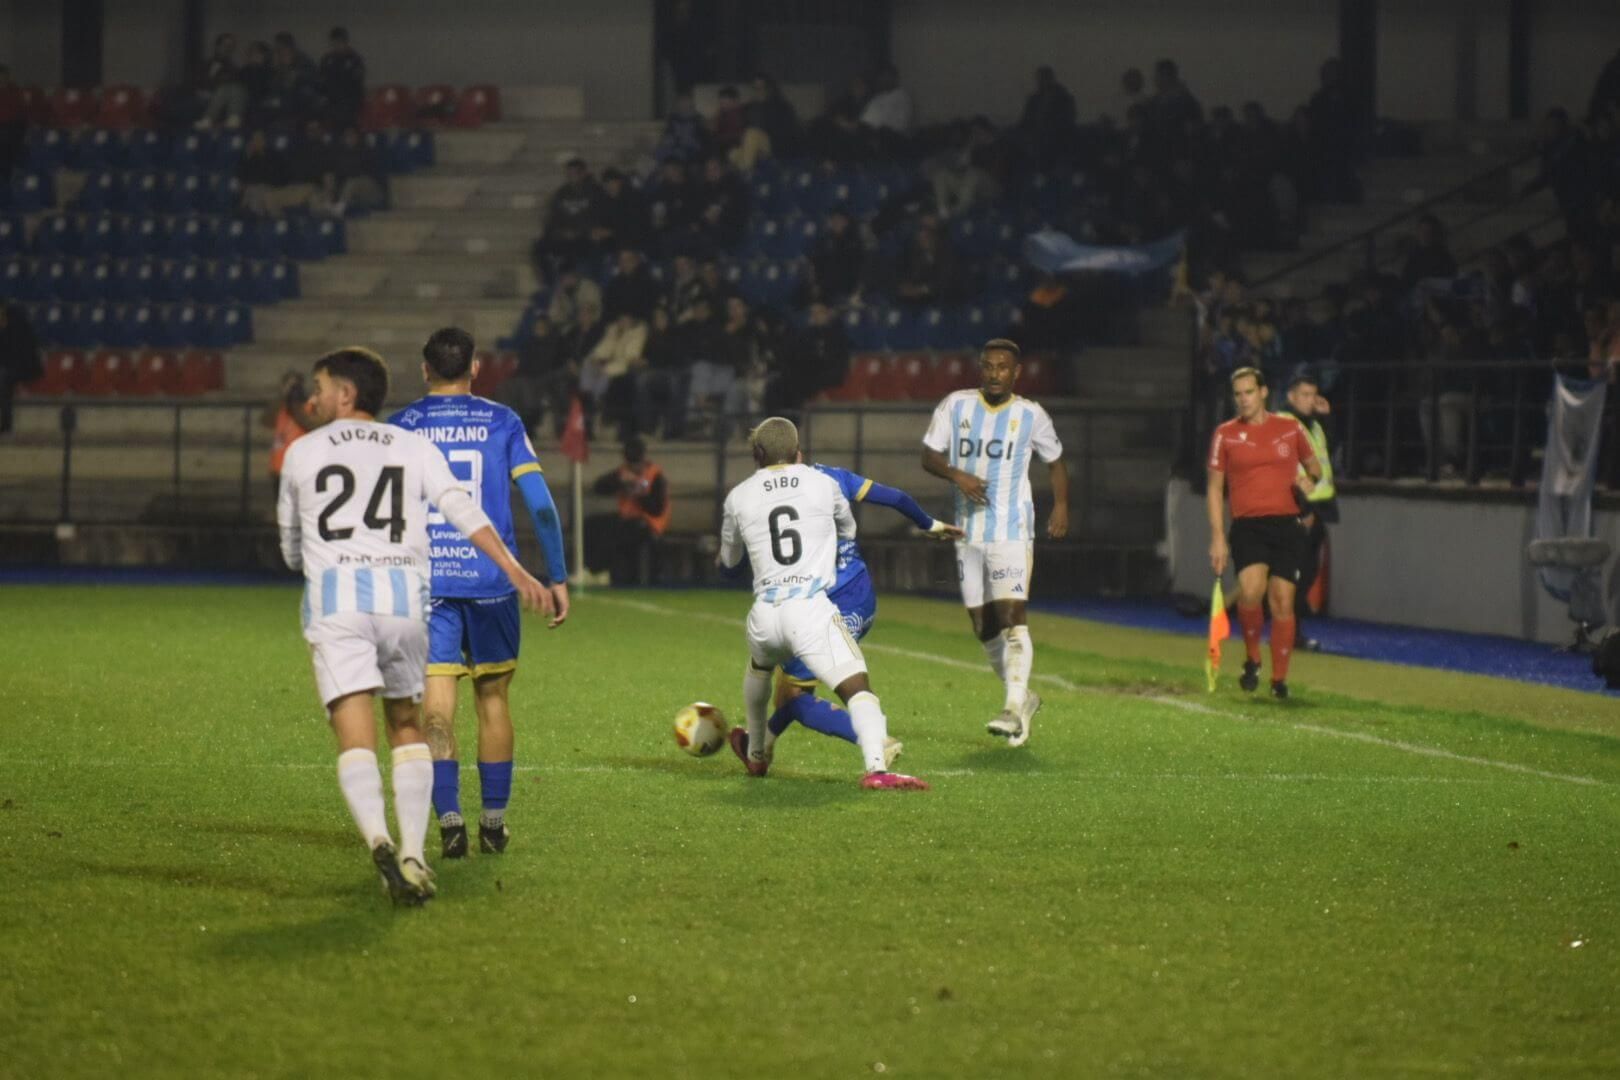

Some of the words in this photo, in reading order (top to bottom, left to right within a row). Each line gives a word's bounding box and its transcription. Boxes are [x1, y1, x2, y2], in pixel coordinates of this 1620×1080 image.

[328, 428, 394, 446] LUCAS
[959, 438, 1014, 460] DIGI
[763, 476, 799, 492] SIBO
[315, 464, 406, 543] 24
[768, 504, 802, 566] 6
